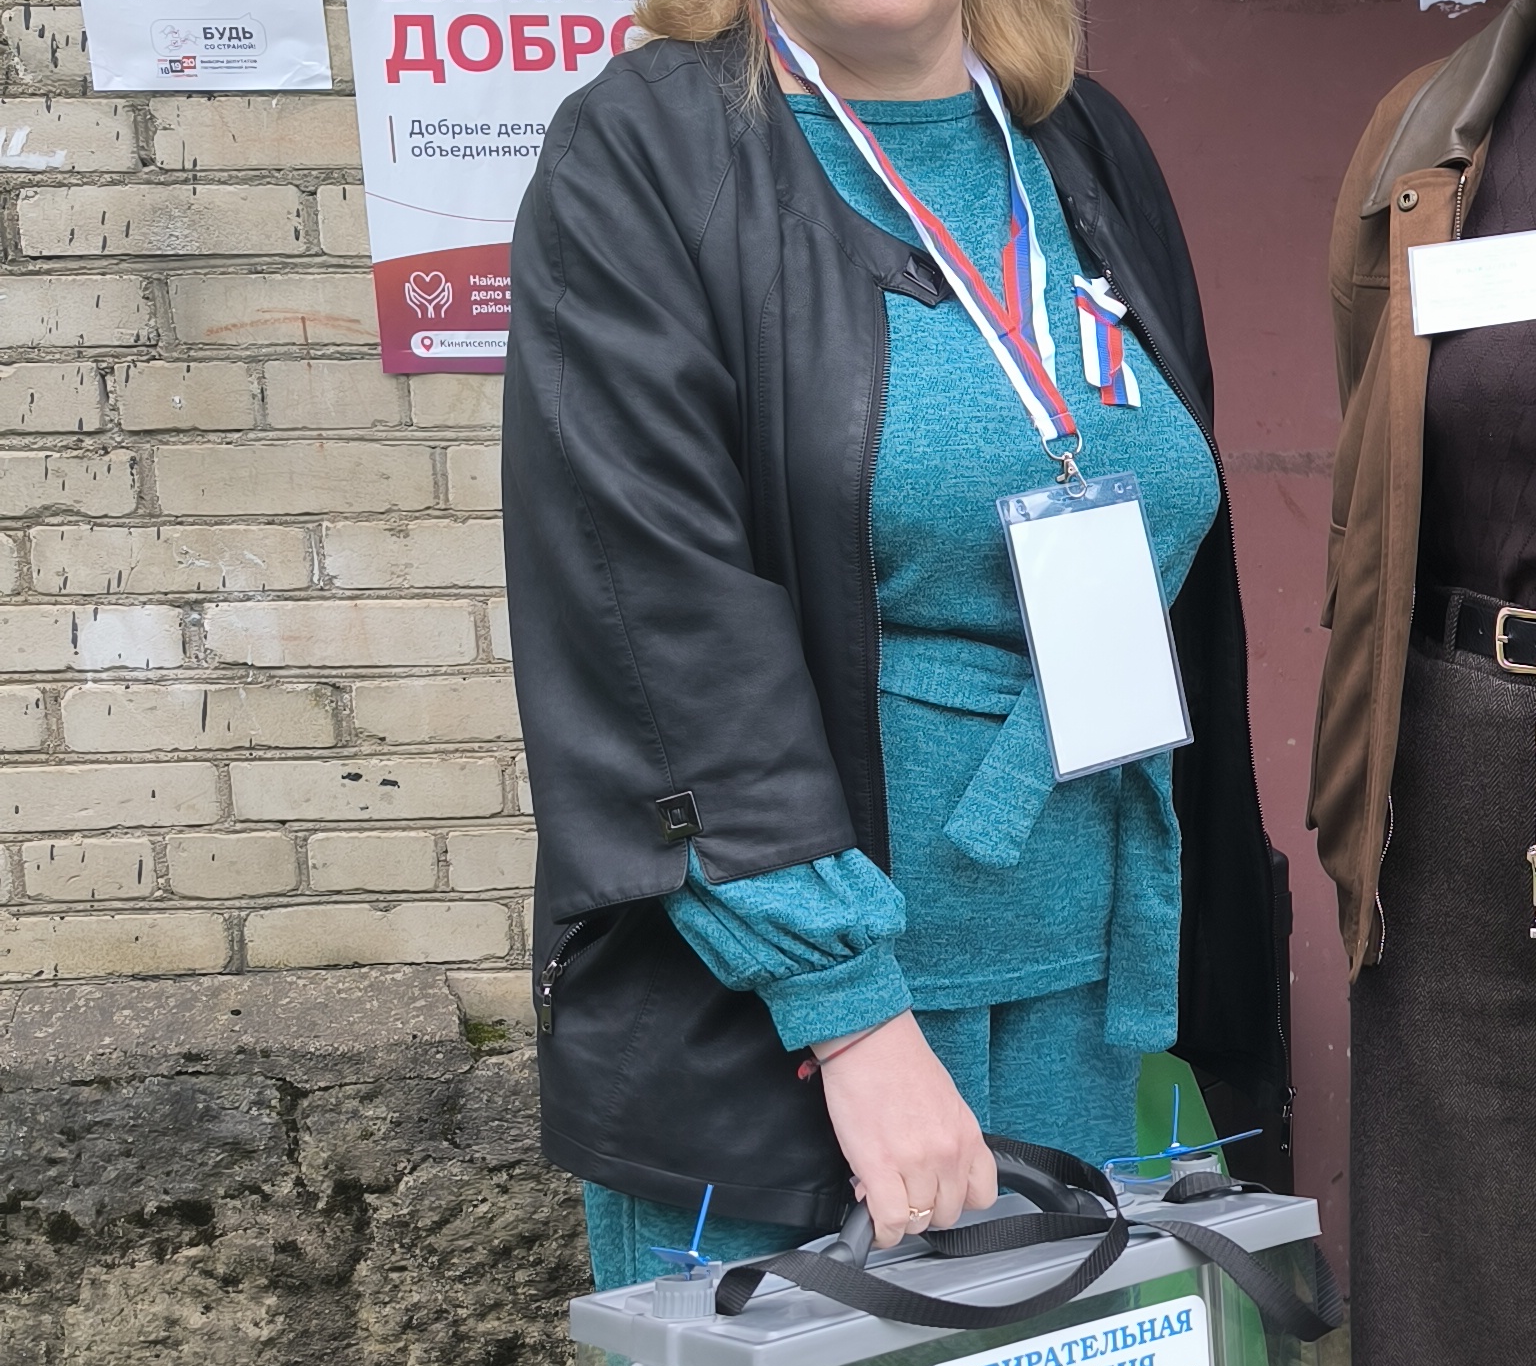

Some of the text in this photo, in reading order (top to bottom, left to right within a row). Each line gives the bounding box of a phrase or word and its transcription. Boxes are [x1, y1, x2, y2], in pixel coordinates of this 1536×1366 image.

[202, 26, 254, 43] БУДЬ
[409, 119, 546, 139] Добрые дела
[411, 141, 541, 160] объединяют
[469, 274, 512, 287] Найди
[470, 290, 503, 301] дело
[472, 302, 512, 315] район
